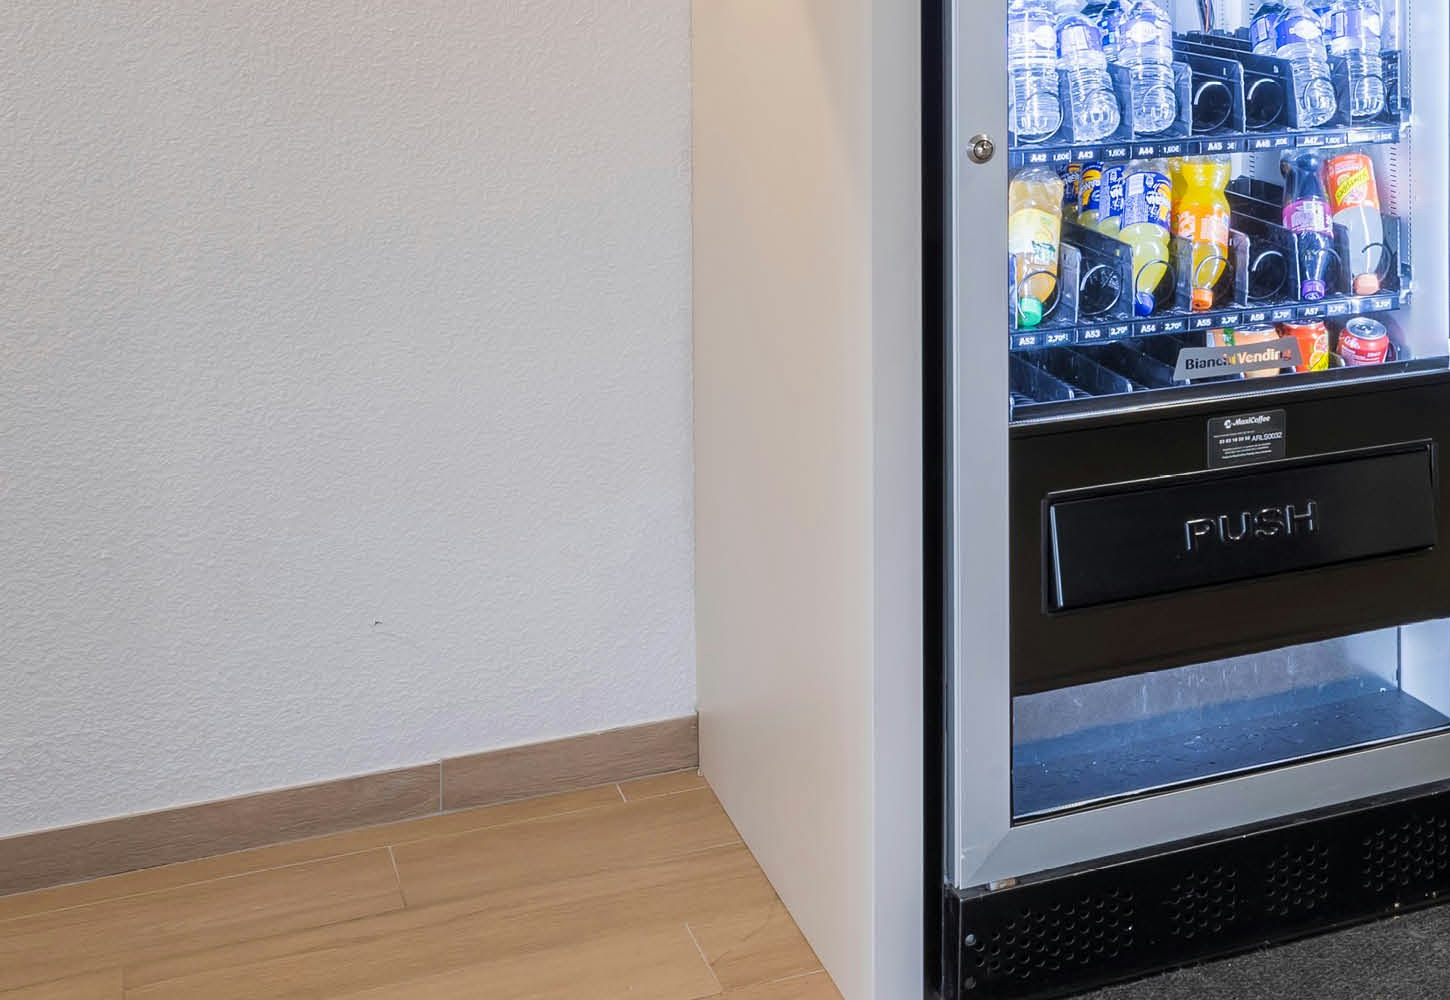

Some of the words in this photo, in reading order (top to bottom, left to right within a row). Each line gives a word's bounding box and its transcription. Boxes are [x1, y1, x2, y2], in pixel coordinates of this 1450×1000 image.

[1304, 307, 1319, 315] A57
[1196, 319, 1212, 327] A55
[1085, 330, 1101, 338] A53
[1019, 337, 1036, 345] A52
[1185, 499, 1320, 551] PUSH
